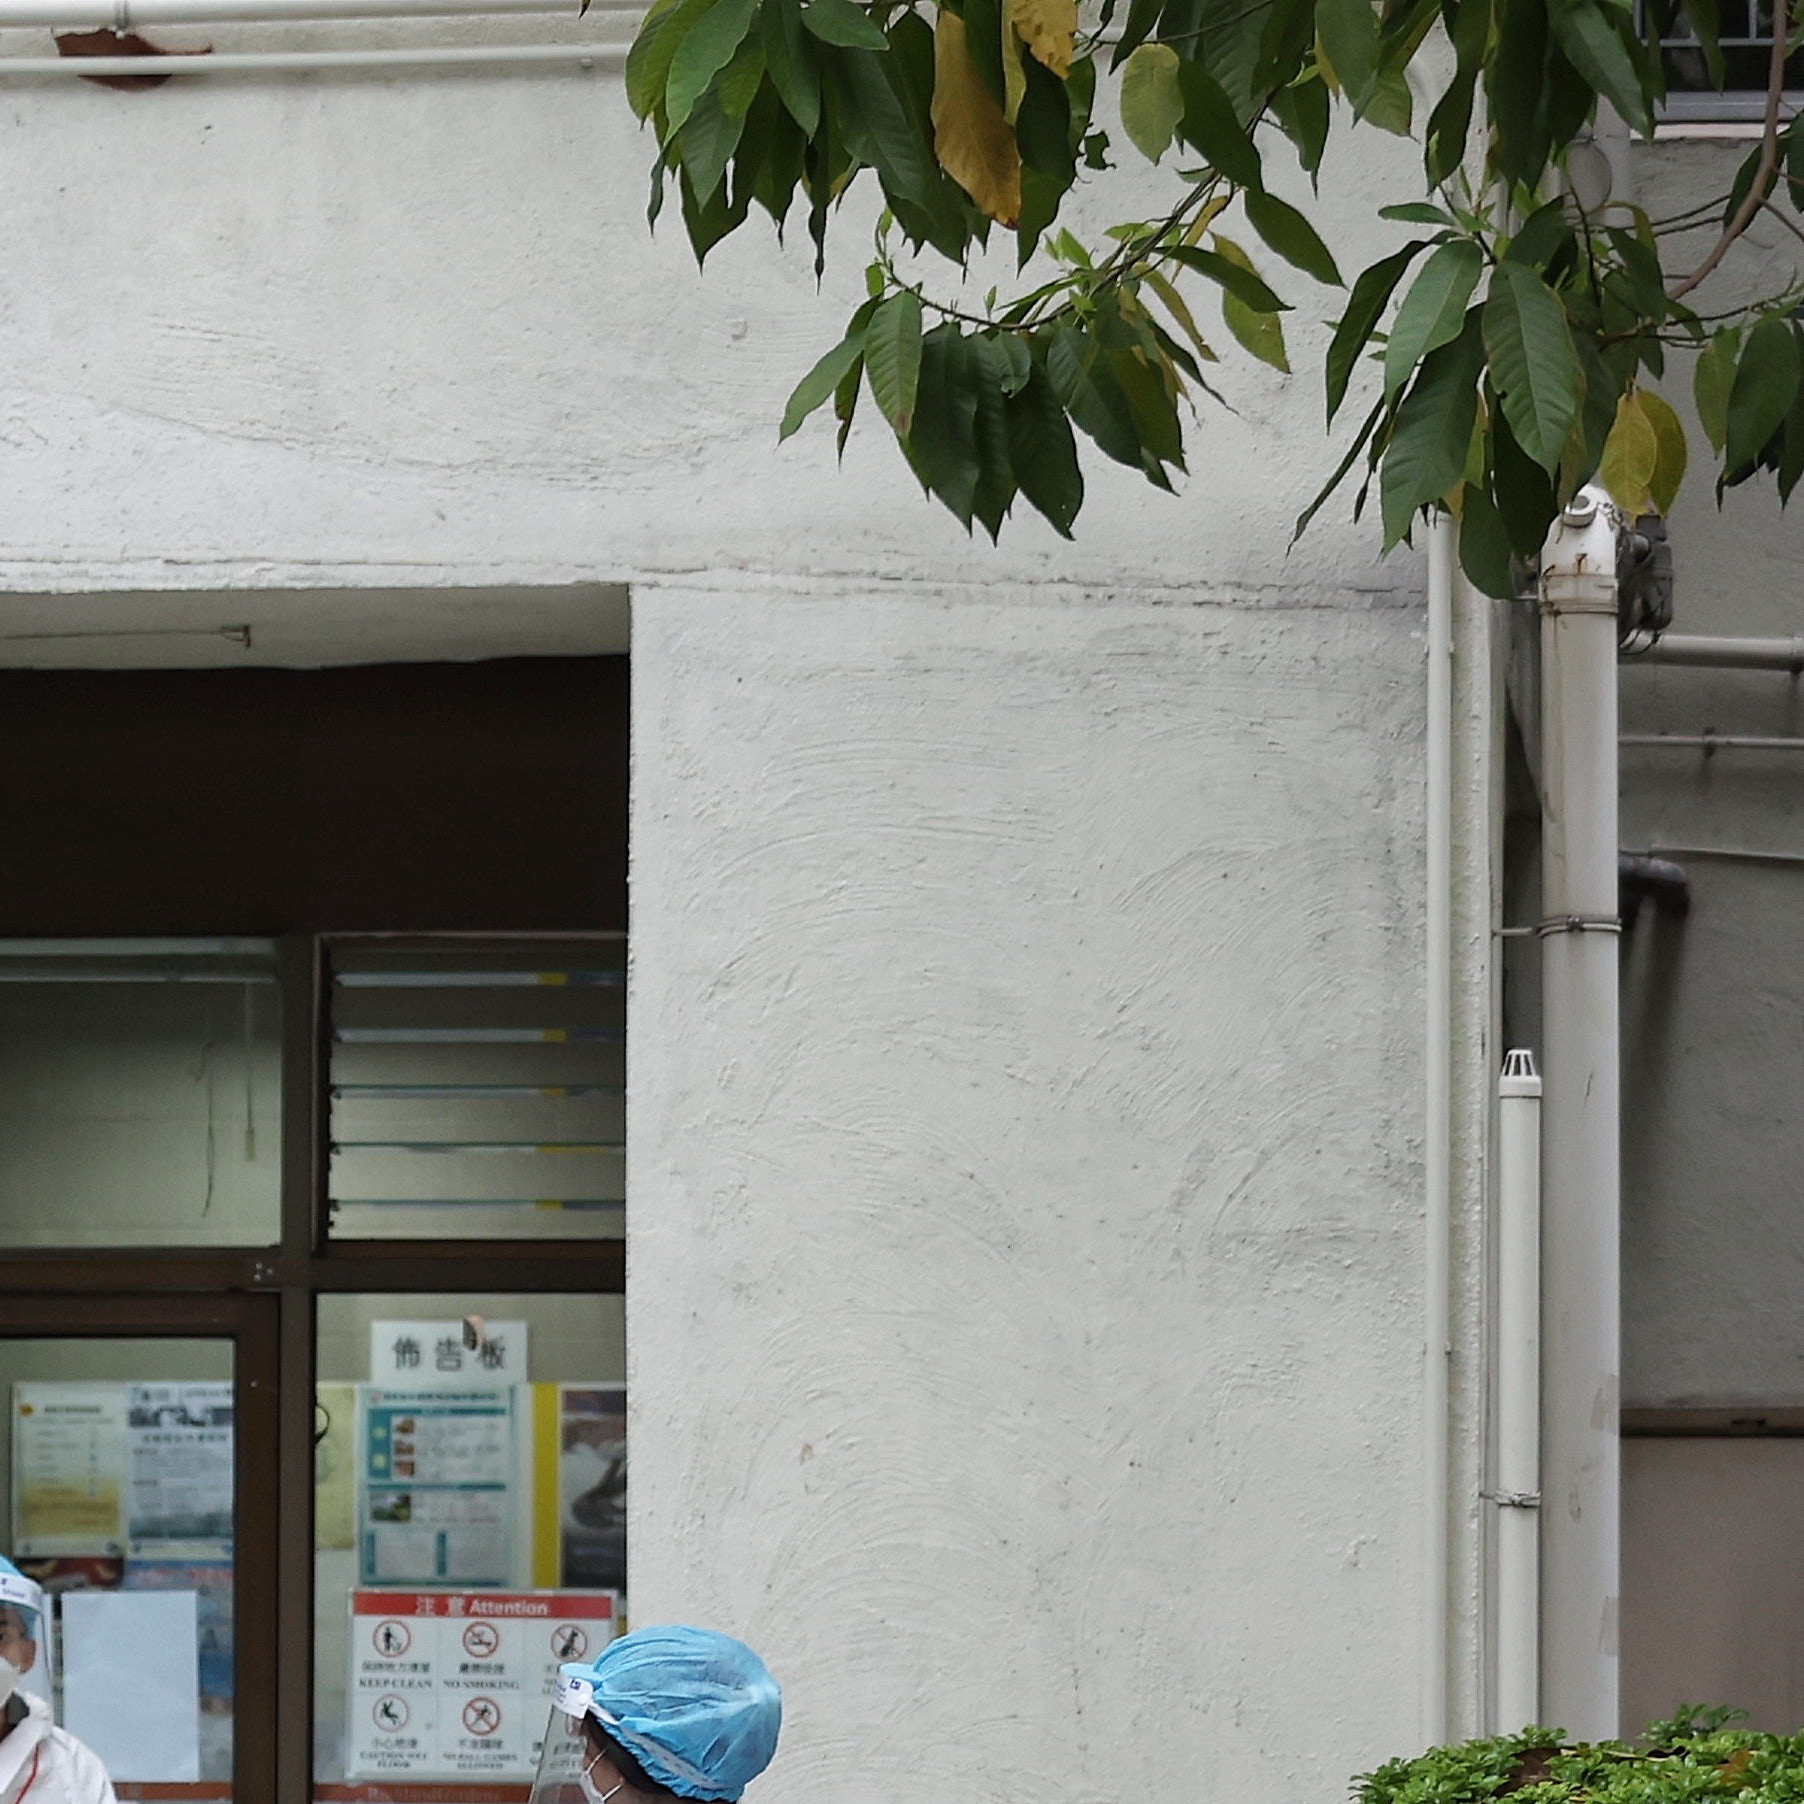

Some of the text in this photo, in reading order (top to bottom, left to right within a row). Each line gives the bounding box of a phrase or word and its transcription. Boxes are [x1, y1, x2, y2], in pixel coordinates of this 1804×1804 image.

[470, 1598, 549, 1616] Attention
[359, 1679, 433, 1689] KEEP CLEAN
[443, 1680, 520, 1690] NO SMOKING
